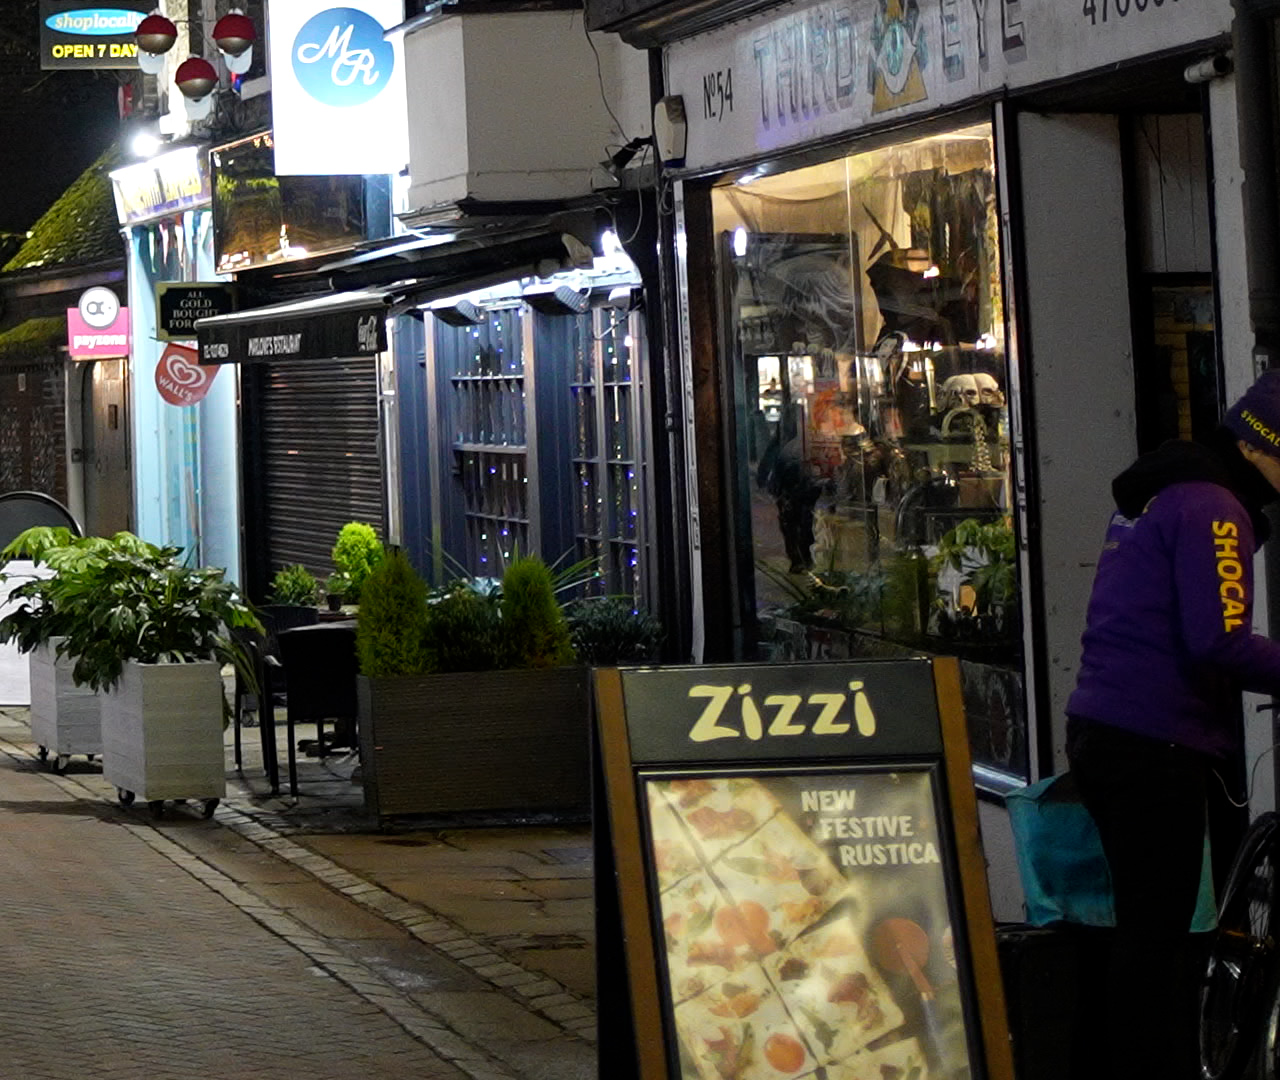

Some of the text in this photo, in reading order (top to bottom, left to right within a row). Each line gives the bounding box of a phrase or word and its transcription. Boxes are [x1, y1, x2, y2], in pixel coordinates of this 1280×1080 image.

[52, 43, 156, 58] OPEN 7 DAY
[753, 8, 858, 131] THIRD
[173, 308, 218, 319] BOUGHT
[180, 299, 212, 308] GOLD
[169, 319, 193, 329] FOR
[73, 335, 127, 349] payzone
[159, 376, 192, 401] WALL'S
[1212, 521, 1245, 633] SHOCAL
[688, 680, 877, 743] Zizzi
[801, 789, 856, 812] NEW
[821, 816, 914, 841] FESTIVE
[841, 843, 940, 866] RUSTICA
